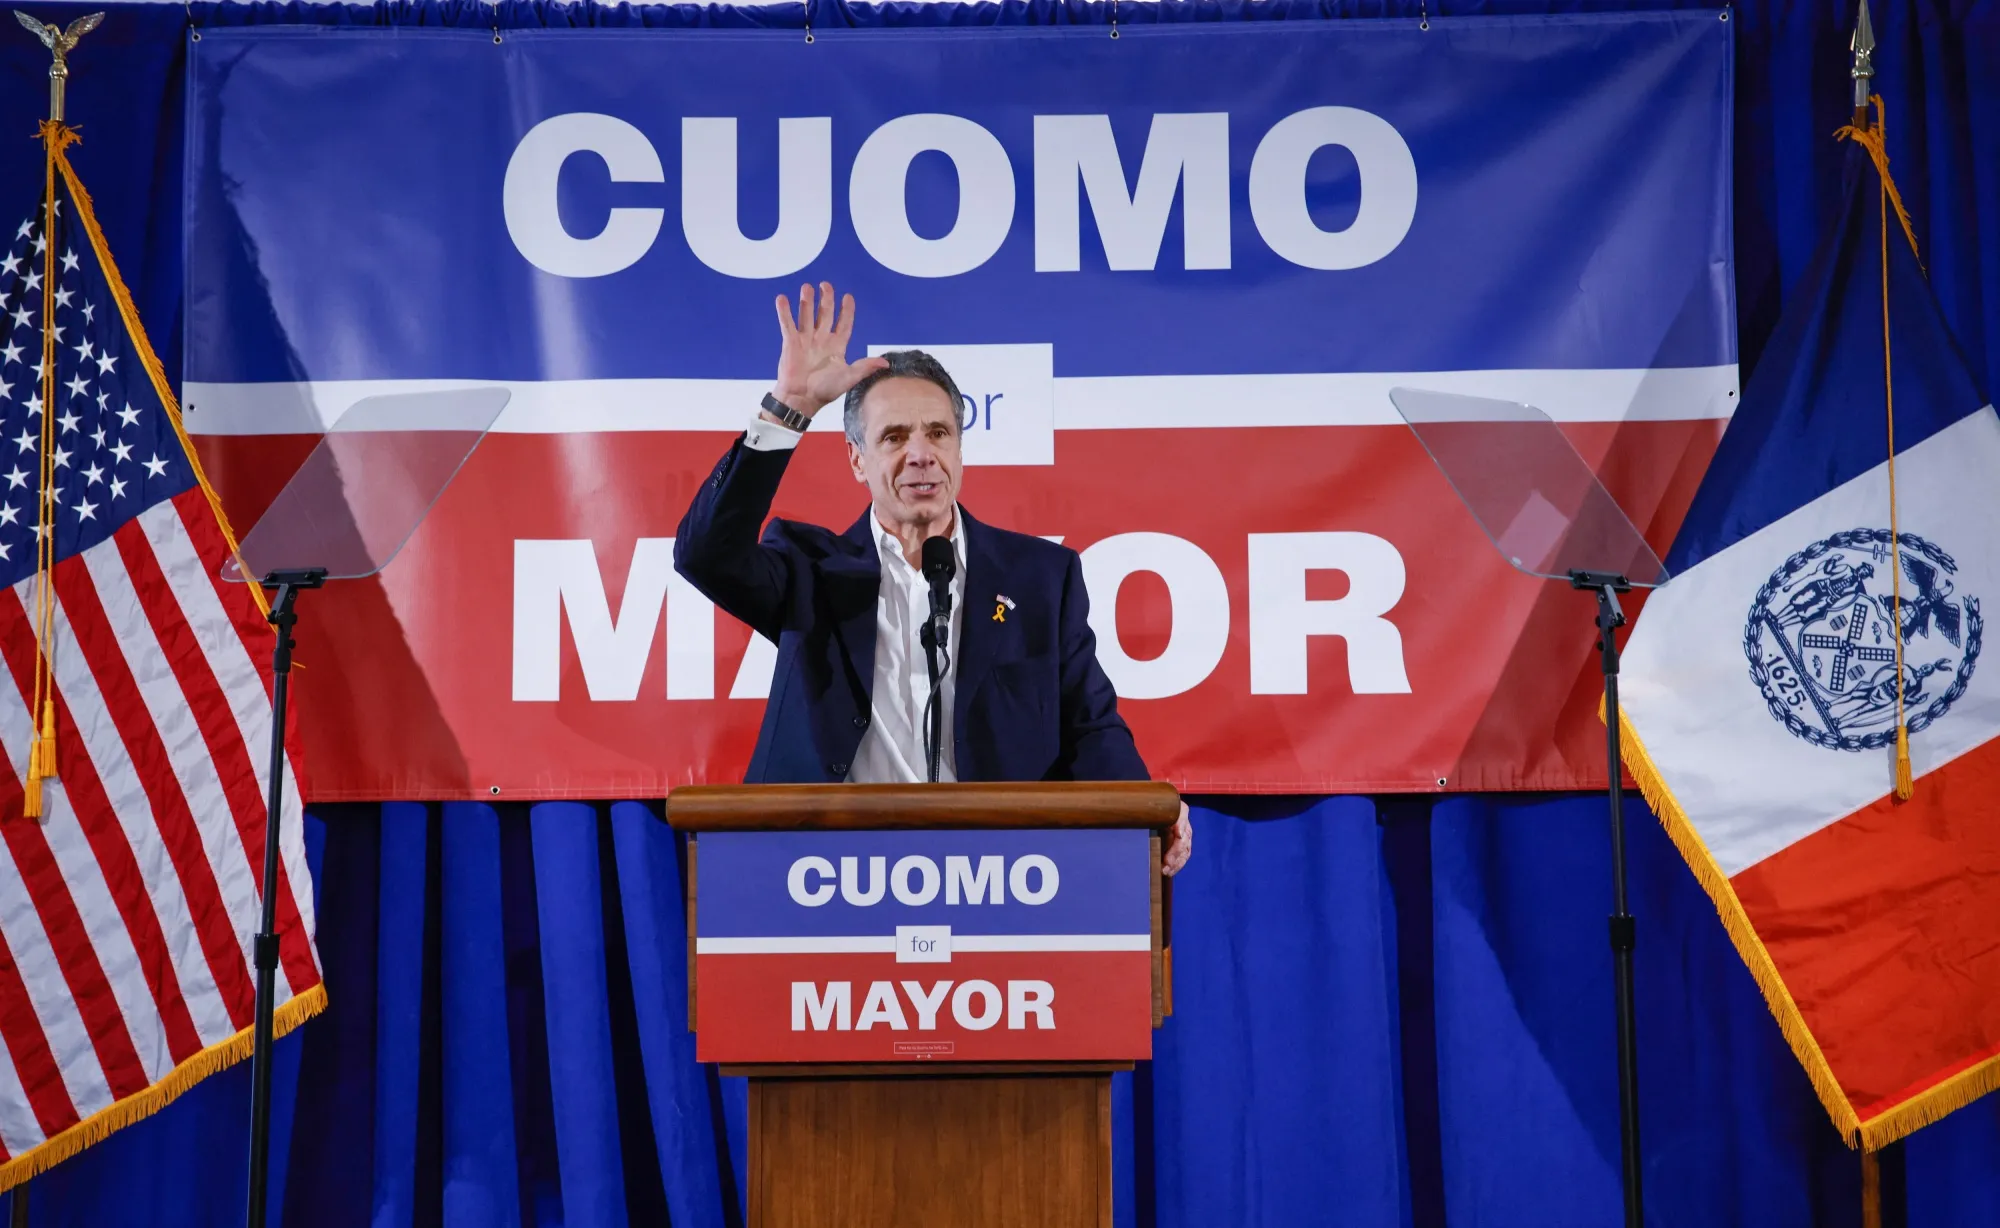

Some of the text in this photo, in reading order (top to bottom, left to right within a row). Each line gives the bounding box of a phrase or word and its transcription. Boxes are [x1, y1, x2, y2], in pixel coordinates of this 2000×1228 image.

[503, 106, 1418, 279] CUOMO
[512, 531, 1412, 701] MOR
[788, 855, 1059, 906] CUOMO
[910, 935, 937, 953] for
[792, 980, 1055, 1030] MAYOR
